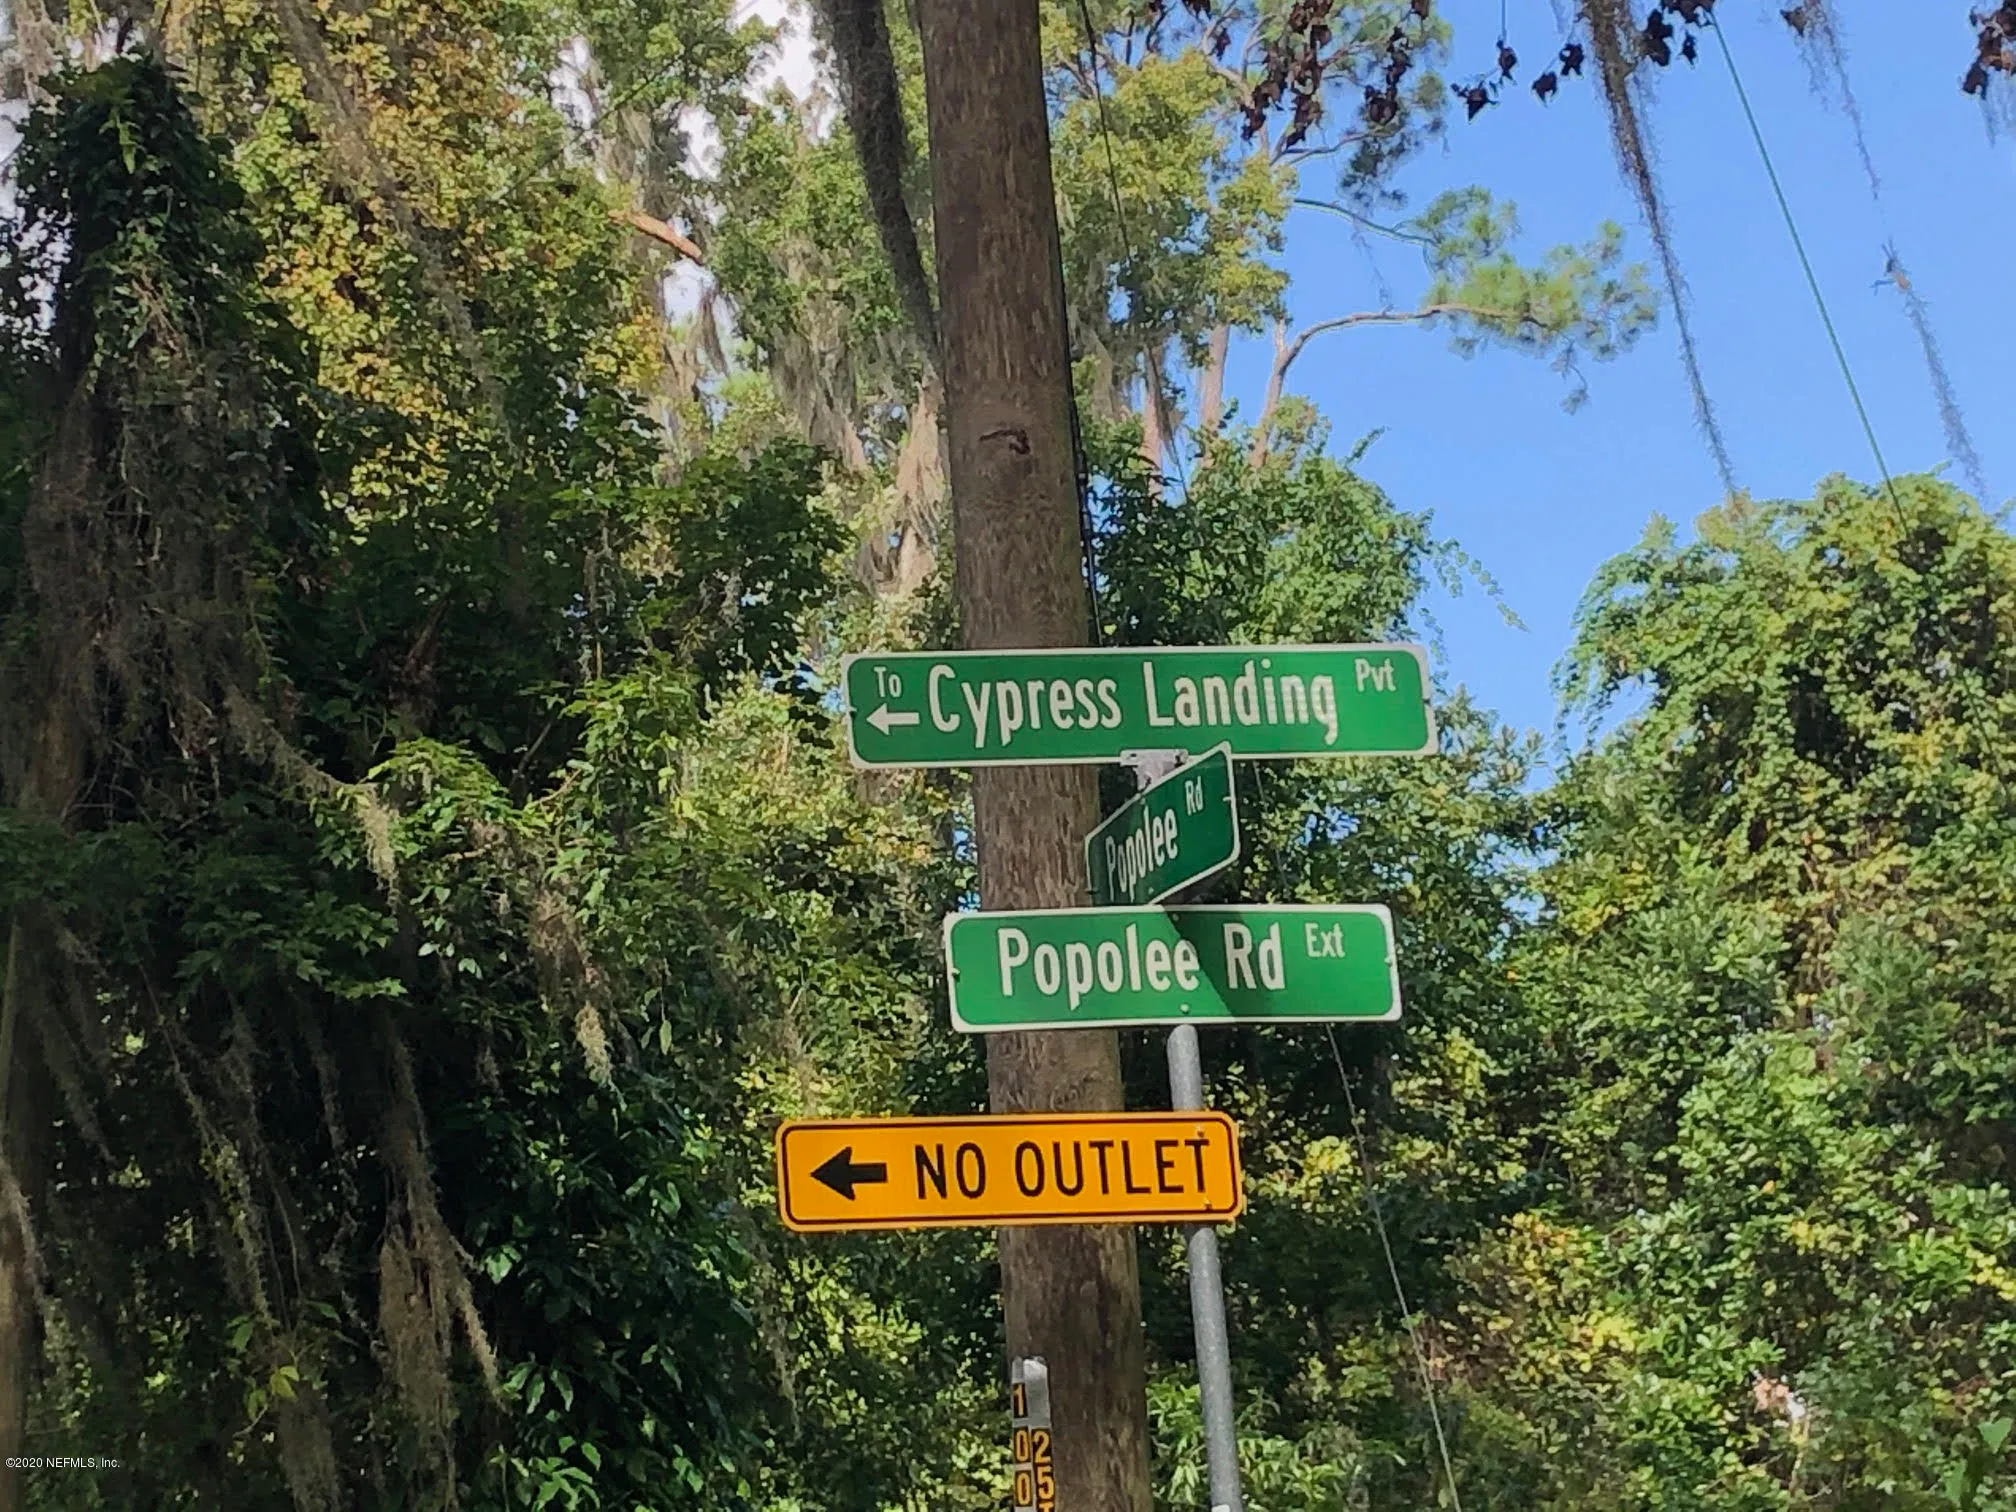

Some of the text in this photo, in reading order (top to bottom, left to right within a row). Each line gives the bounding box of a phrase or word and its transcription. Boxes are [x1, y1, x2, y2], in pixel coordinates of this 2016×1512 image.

[873, 658, 1398, 749] To Cypress Landing Pvt
[1105, 776, 1204, 903] Popolee Rd
[997, 922, 1346, 1010] Popolee Rd Ext
[915, 1139, 1211, 1200] NO OUTLET
